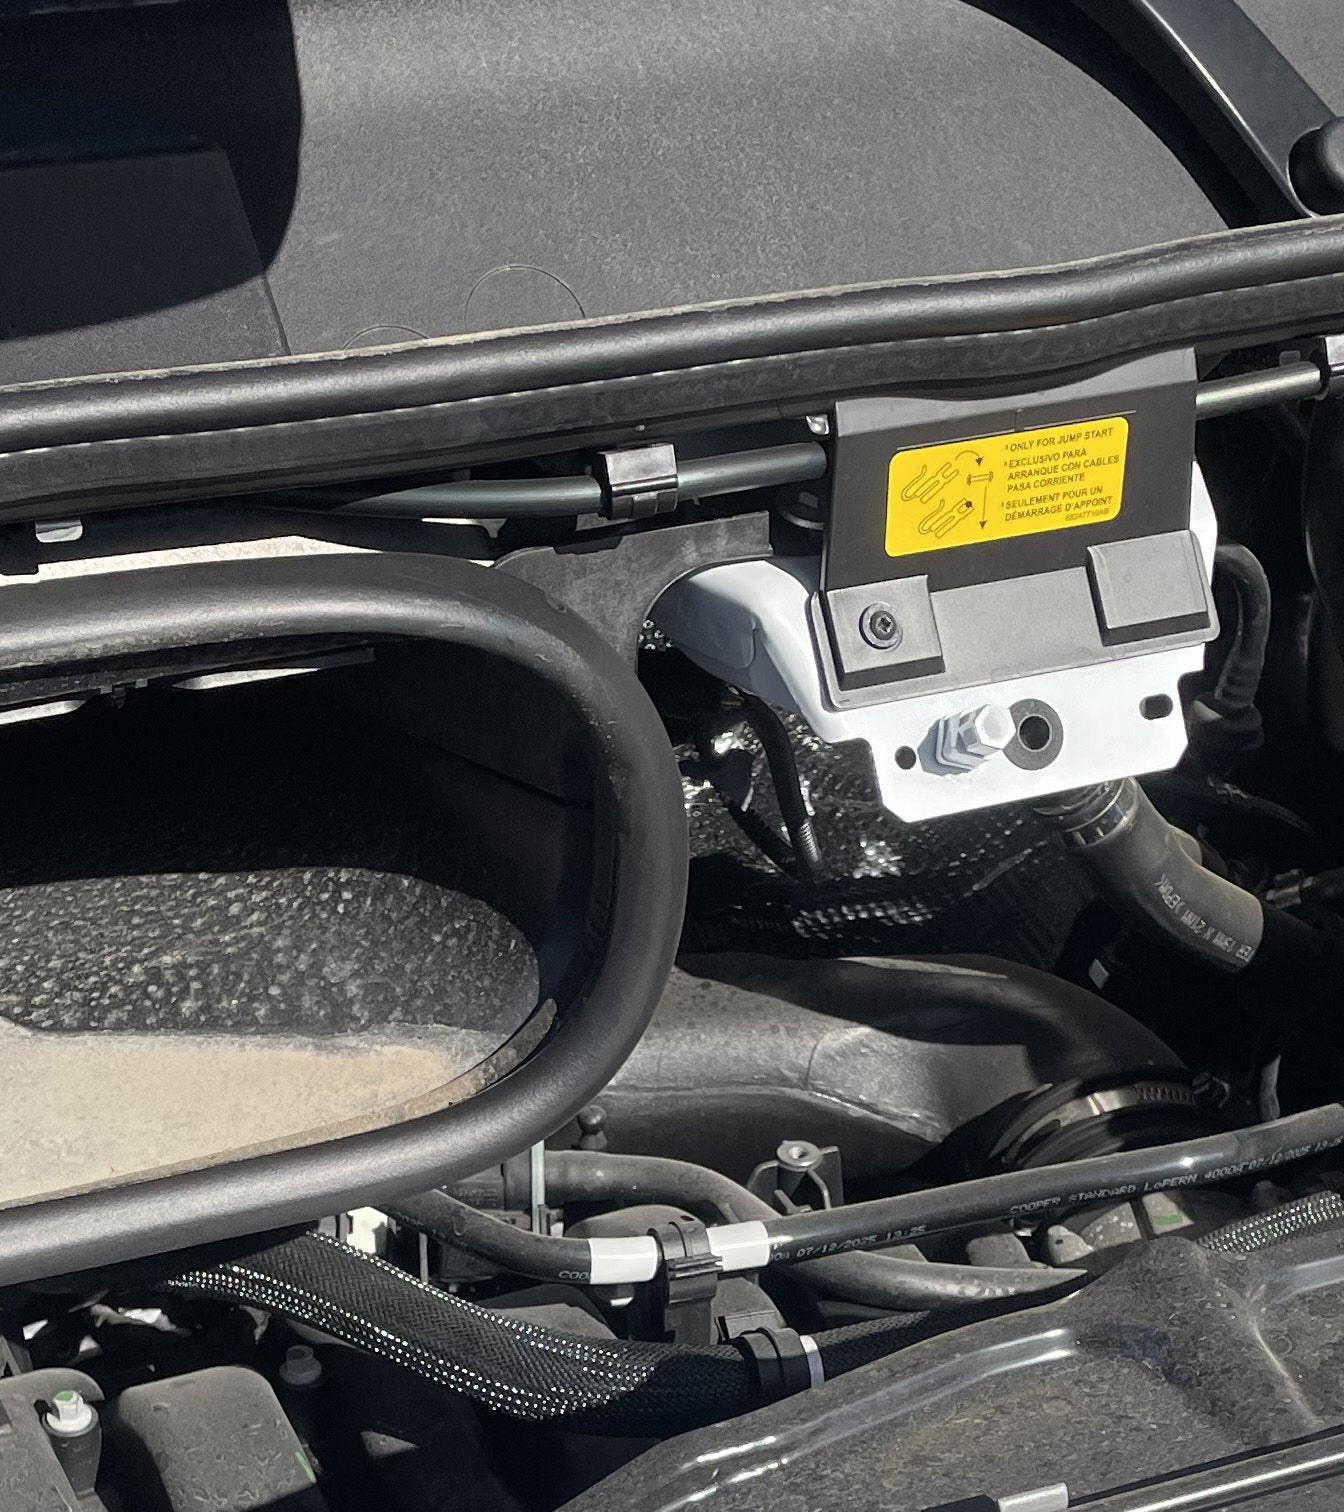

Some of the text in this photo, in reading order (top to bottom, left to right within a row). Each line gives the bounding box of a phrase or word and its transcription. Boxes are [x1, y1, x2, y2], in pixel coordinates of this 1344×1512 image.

[1010, 427, 1114, 452] ONLY FOR JUMP START
[1008, 455, 1120, 480] ARRANQUE CON CABLES
[1009, 448, 1087, 468] EXCLUSIVO PARA
[1007, 472, 1086, 493] PASA CORRIENTE
[1005, 496, 1113, 521] DÉMARRAGE D'APPOINT
[1006, 485, 1103, 510] SEULEMENT POUR UN
[1068, 1184, 1137, 1201] STANDARD
